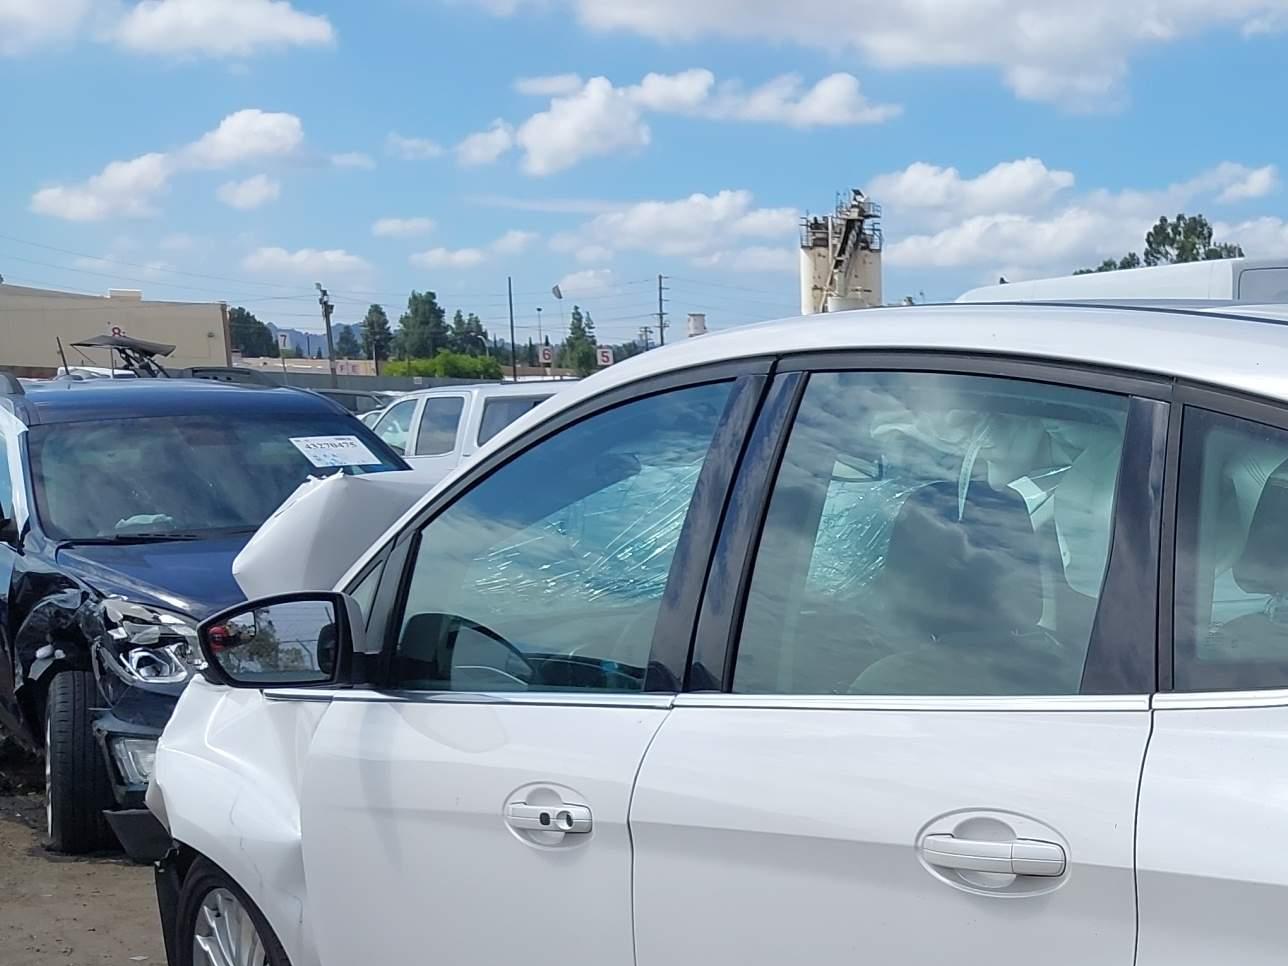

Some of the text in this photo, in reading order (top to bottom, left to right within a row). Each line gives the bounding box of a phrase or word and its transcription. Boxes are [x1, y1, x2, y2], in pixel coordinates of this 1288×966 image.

[280, 334, 287, 348] 7
[542, 348, 551, 361] 6
[601, 350, 610, 364] 5
